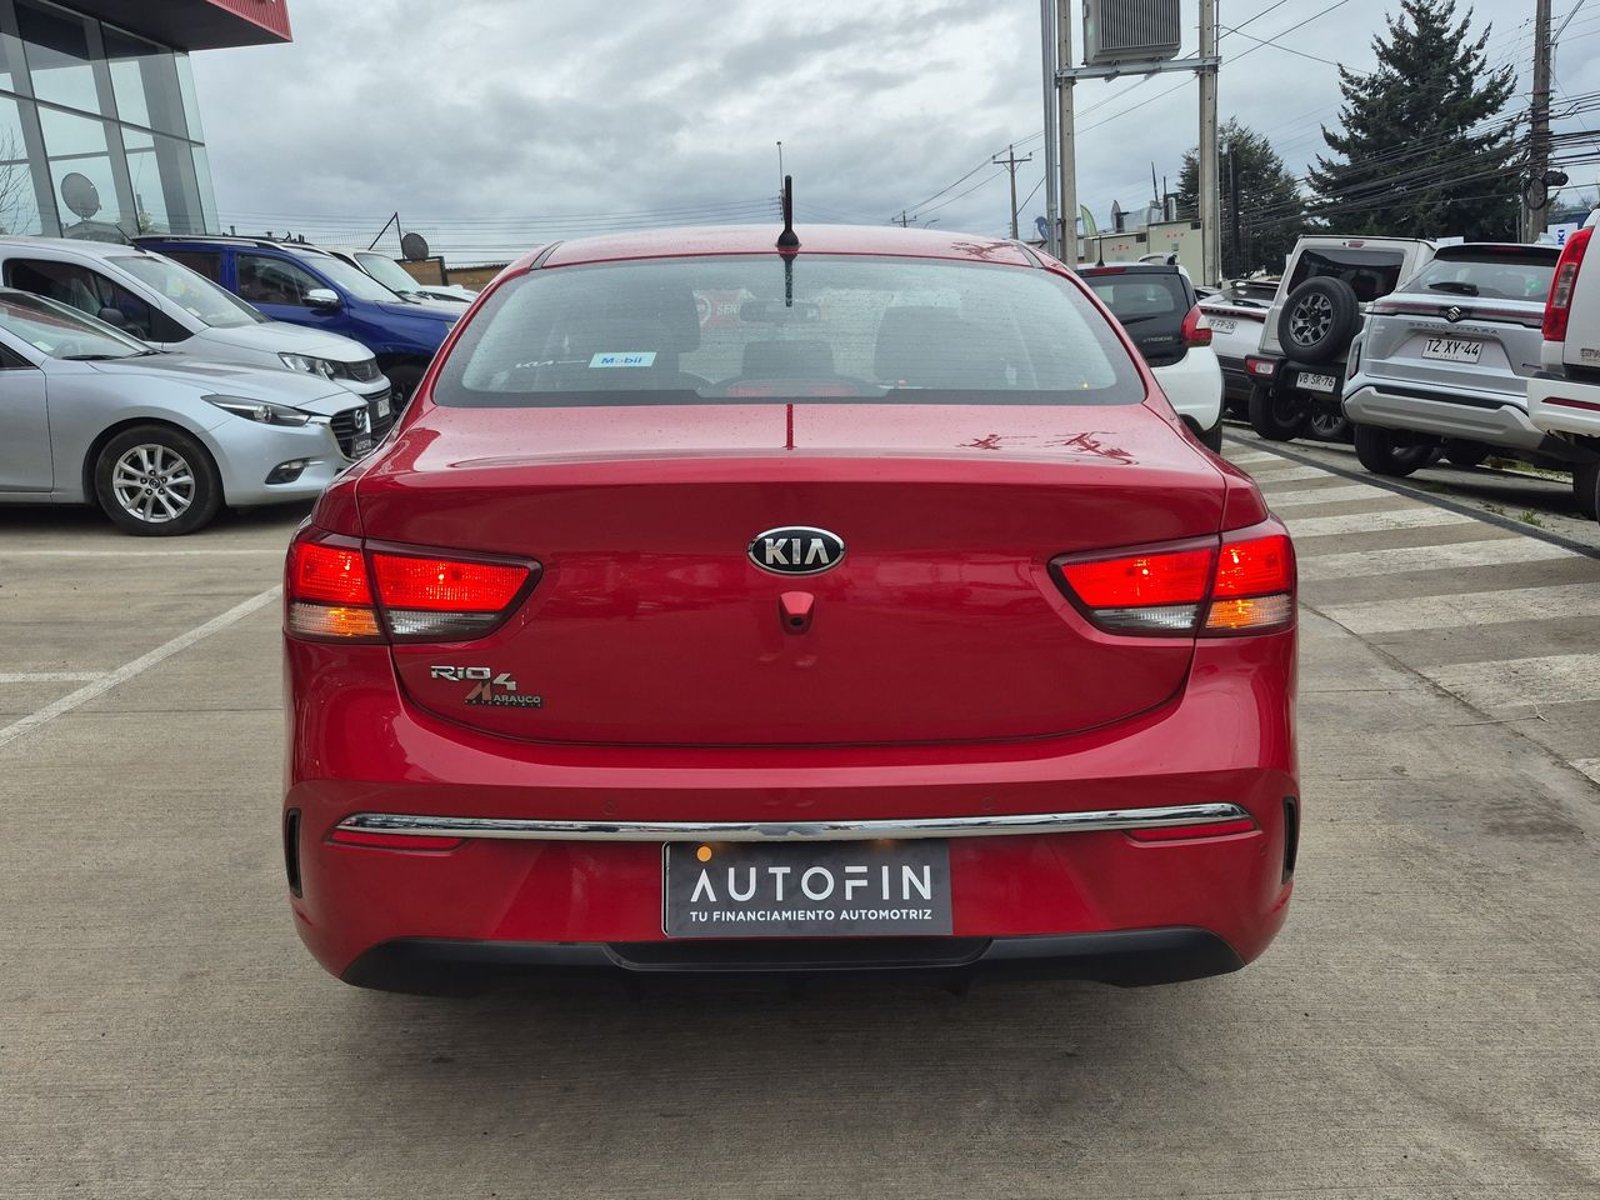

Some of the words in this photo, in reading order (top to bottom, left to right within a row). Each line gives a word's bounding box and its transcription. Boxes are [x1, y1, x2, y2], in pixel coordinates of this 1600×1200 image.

[764, 538, 830, 565] KIA
[690, 865, 932, 902] AUTOFIN
[690, 911, 708, 922] TU
[713, 910, 835, 921] FINANCIAMIENTO
[840, 909, 933, 920] AUTOMOTRIZ
